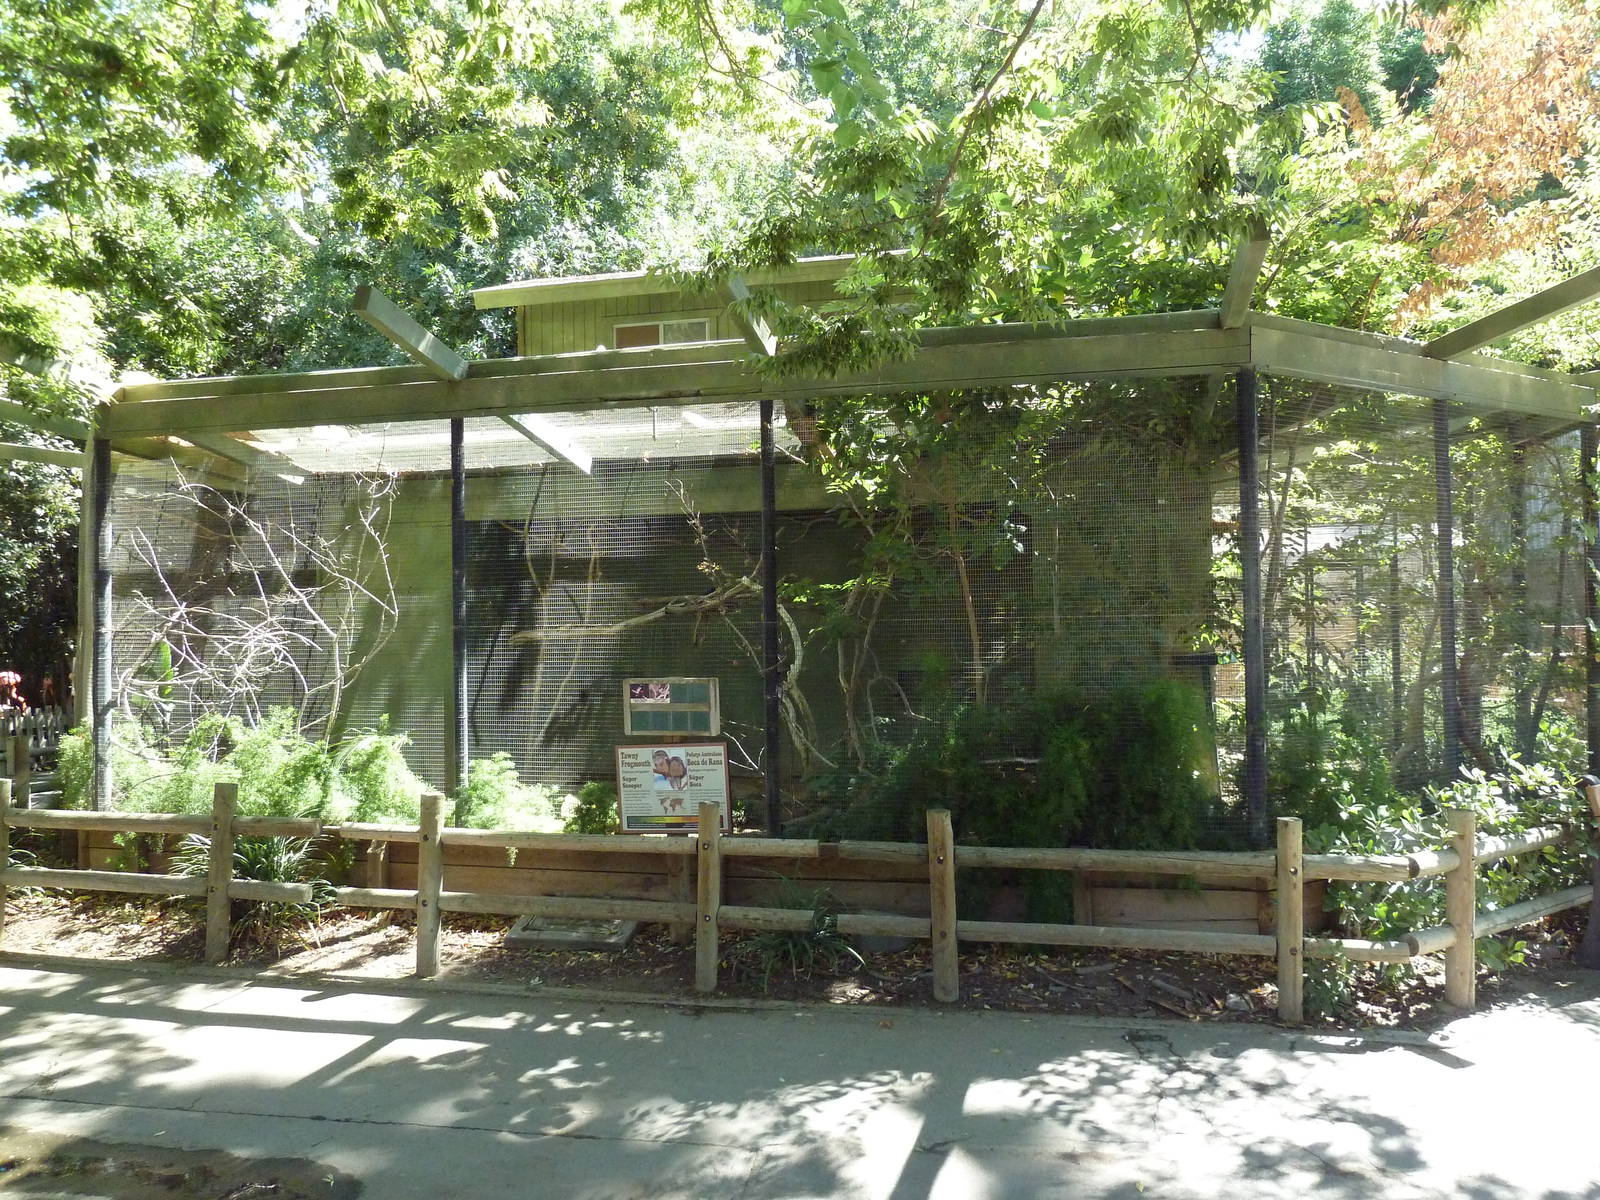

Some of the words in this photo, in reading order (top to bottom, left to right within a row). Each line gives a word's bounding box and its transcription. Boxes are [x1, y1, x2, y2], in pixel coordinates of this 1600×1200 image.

[621, 752, 638, 760] Tawny
[621, 760, 651, 769] Frogmouth
[701, 758, 707, 766] de
